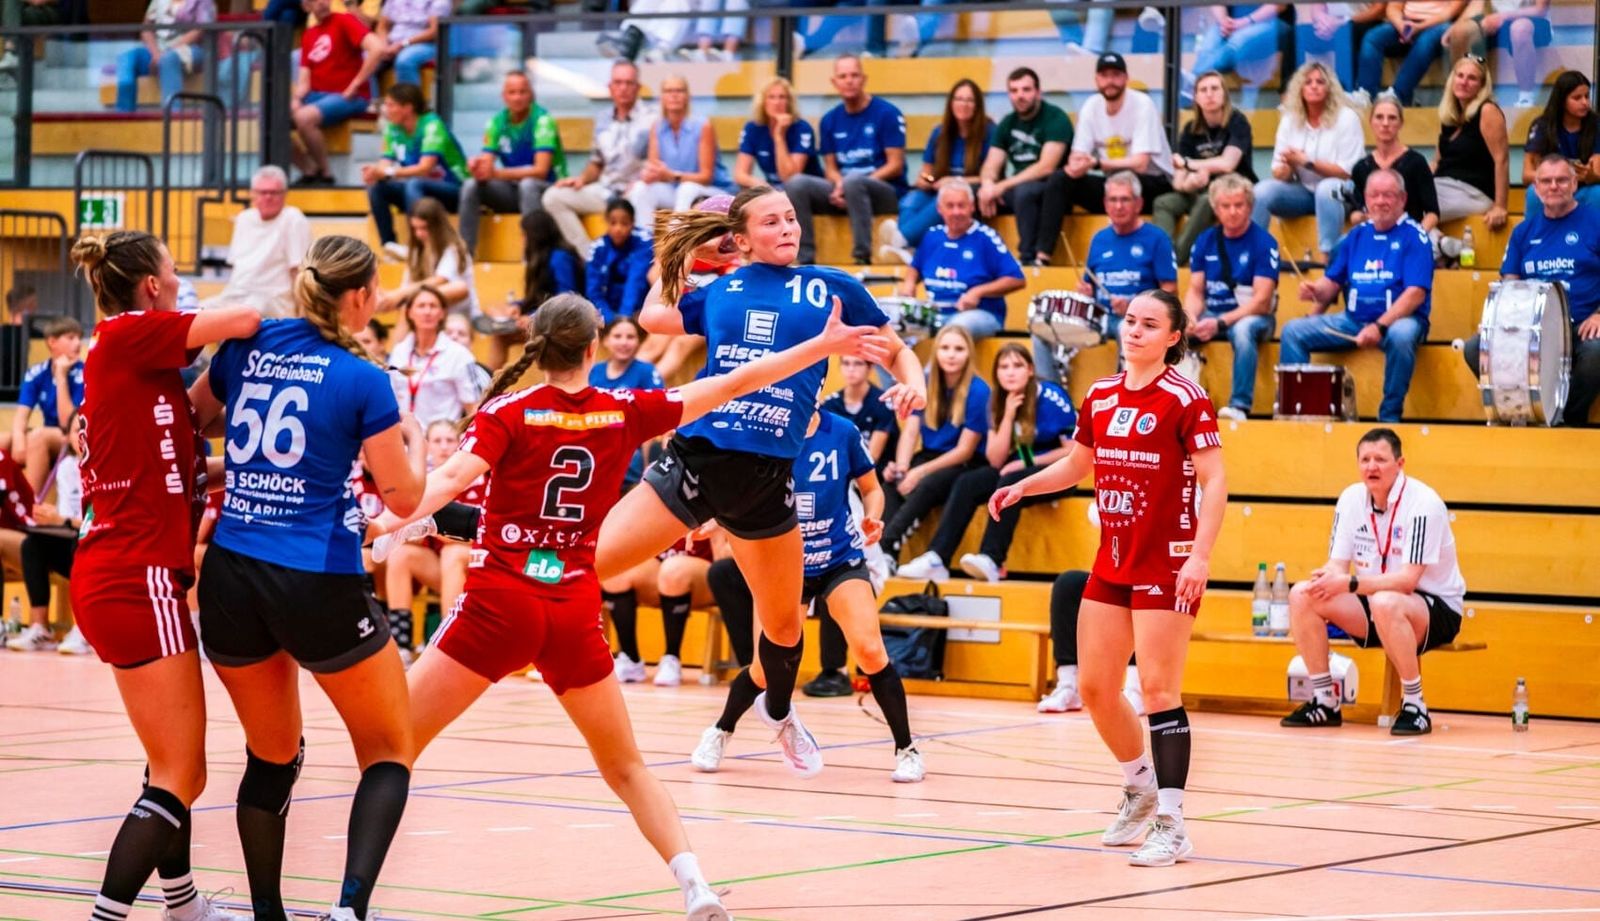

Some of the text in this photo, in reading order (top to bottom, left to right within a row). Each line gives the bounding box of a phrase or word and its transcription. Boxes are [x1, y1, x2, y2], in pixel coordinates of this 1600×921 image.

[1537, 257, 1575, 271] SCHÖCK
[785, 274, 828, 309] 10
[715, 344, 776, 361] Fisc
[242, 349, 276, 378] SG
[758, 384, 795, 399] ydraulik
[227, 382, 309, 469] 56
[526, 411, 564, 425] PRINT
[585, 413, 625, 426] PIXEL
[742, 414, 789, 428] AUTOMOBILE
[1096, 446, 1160, 463] develop group
[808, 449, 839, 482] 21
[238, 472, 306, 495] SCHÖCK
[540, 445, 595, 522] 2
[1098, 489, 1135, 516] KDE
[799, 517, 834, 532] cher
